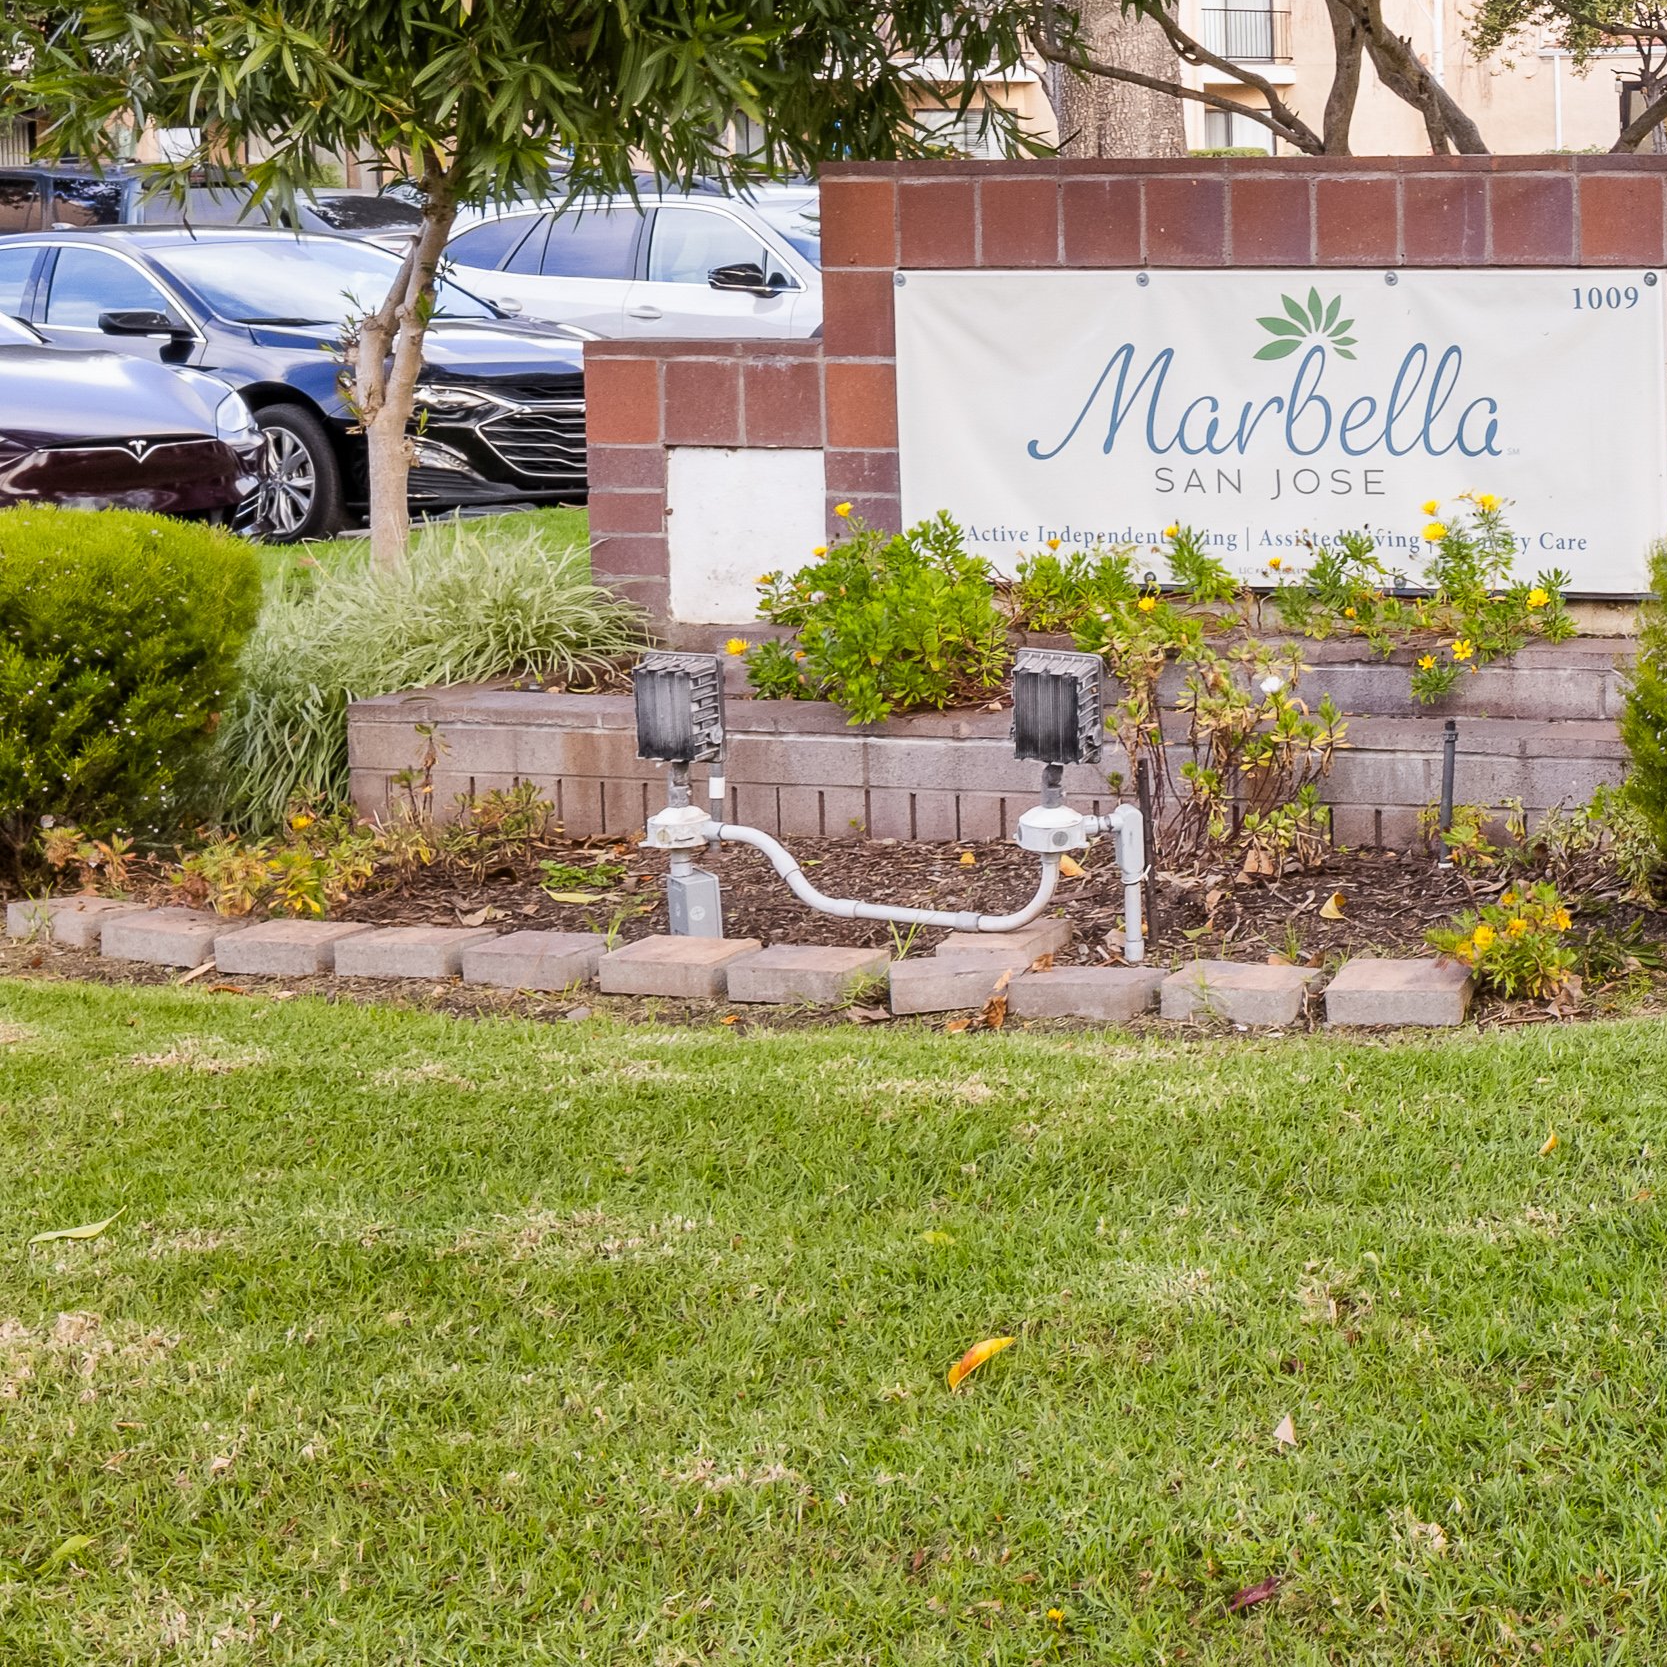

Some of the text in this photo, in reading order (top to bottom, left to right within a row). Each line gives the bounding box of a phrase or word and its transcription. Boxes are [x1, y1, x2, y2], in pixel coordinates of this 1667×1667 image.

[1571, 286, 1639, 310] 1009
[1027, 342, 1503, 460] Marbella
[1154, 466, 1386, 501] SAN JOSE
[966, 524, 1030, 543] Active
[1037, 525, 1167, 549] Independent
[1168, 529, 1238, 552] ving
[1259, 529, 1345, 547] Assisted
[1539, 531, 1587, 551] Care
